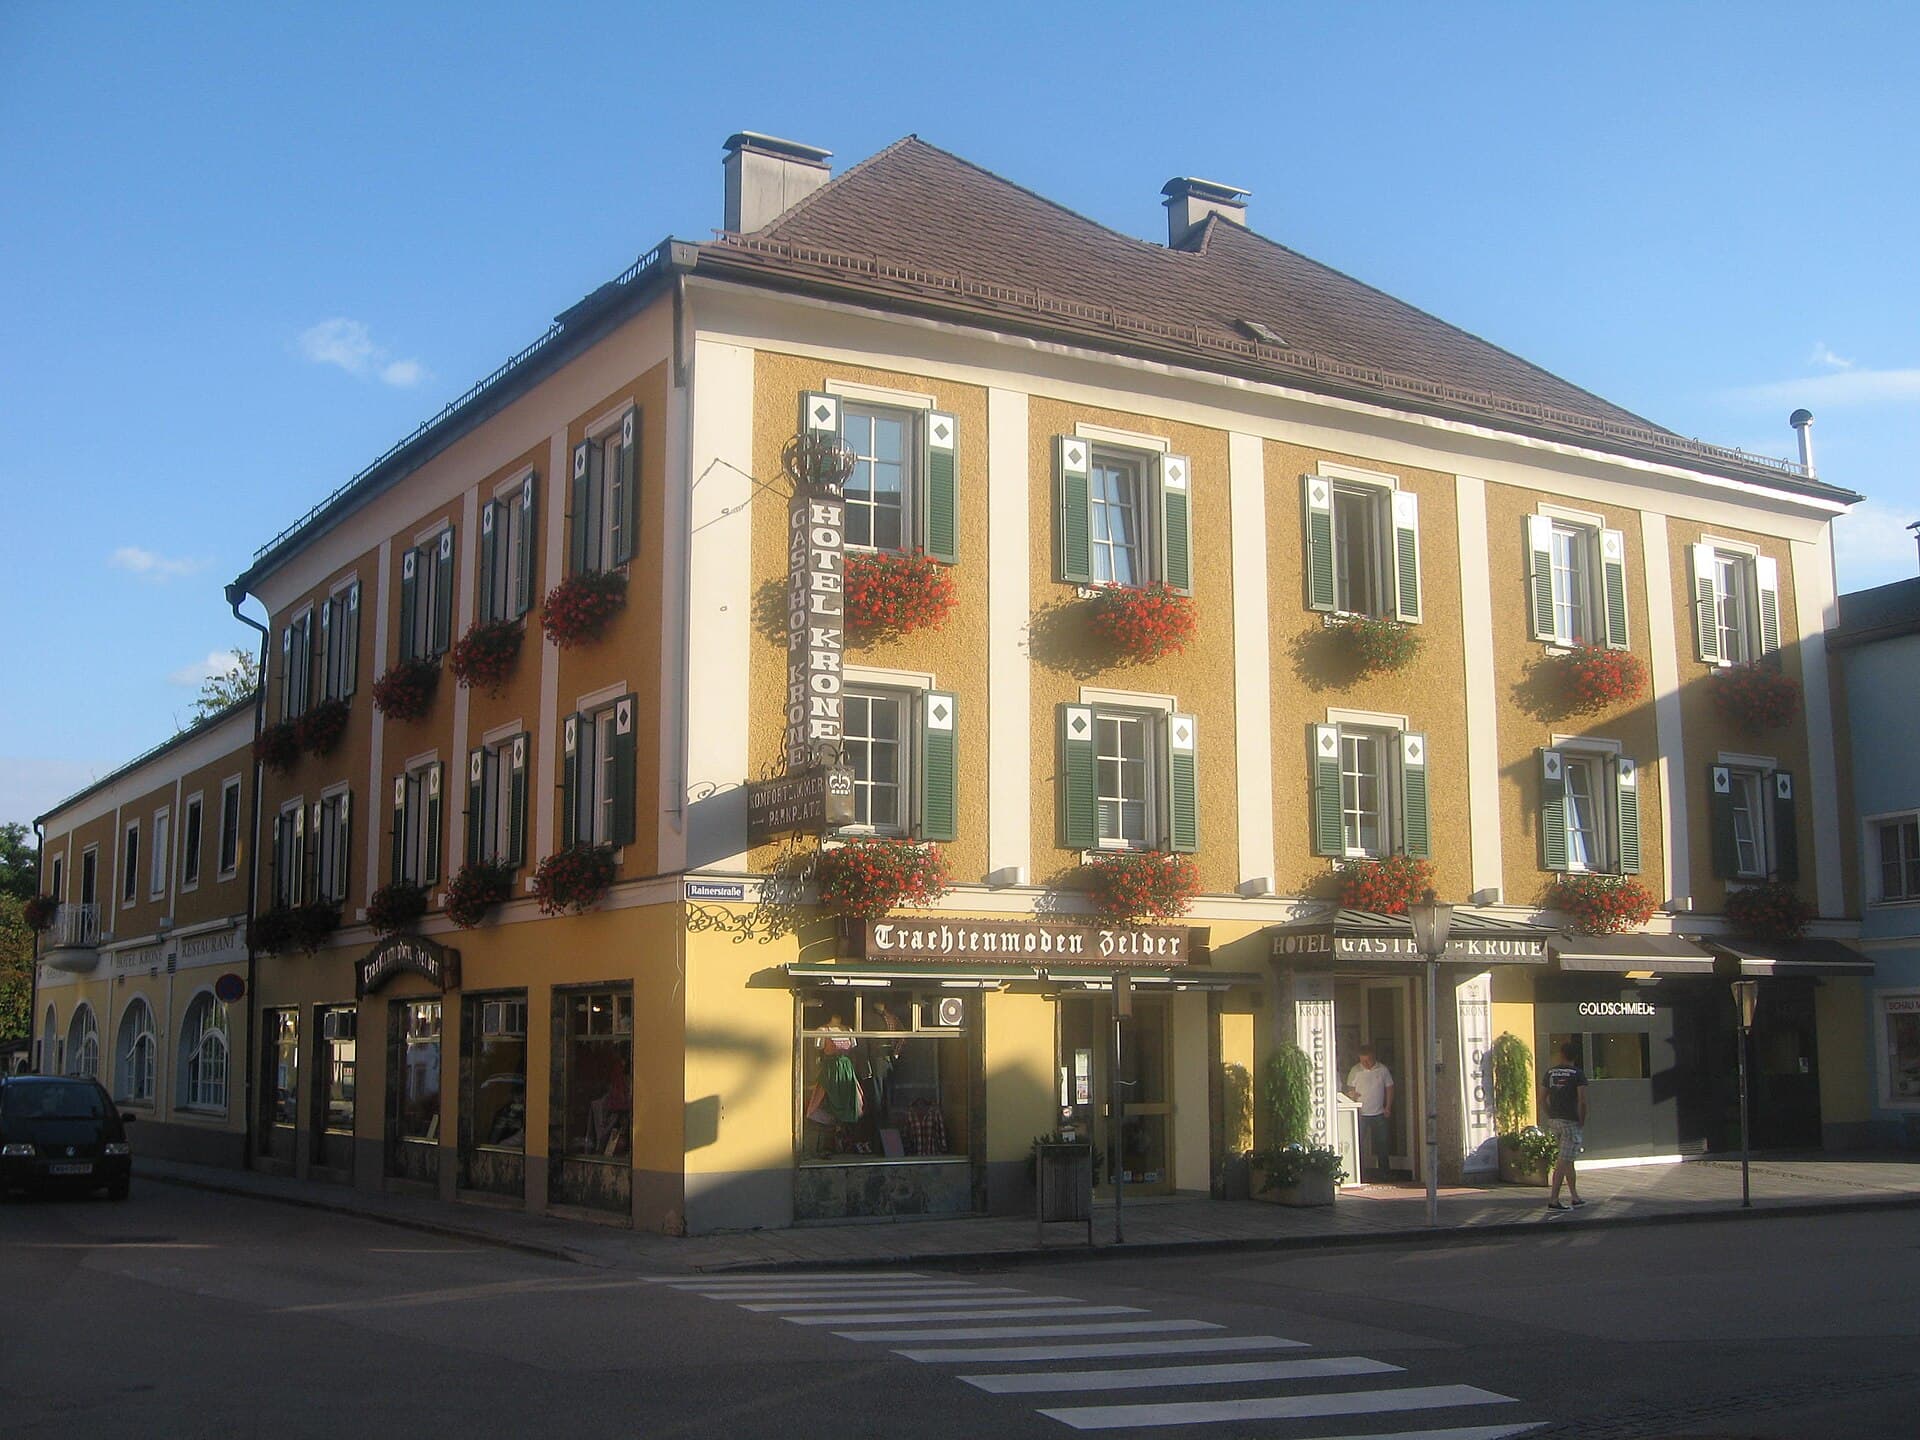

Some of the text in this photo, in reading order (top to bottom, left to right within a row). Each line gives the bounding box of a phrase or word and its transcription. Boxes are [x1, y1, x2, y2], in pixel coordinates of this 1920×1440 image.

[810, 504, 842, 741] HOTEL KRONE
[789, 508, 806, 767] GASTHOF KRONE
[691, 885, 742, 896] Rainerstraße
[181, 935, 235, 958] RESTAURANT
[874, 923, 1084, 954] Trachtenmoden
[1272, 933, 1331, 955] HOTEL
[1467, 939, 1544, 957] KRONE
[1299, 1005, 1332, 1017] KRONE
[1459, 1005, 1489, 1017] KRONE
[1578, 1002, 1656, 1016] GOLDSCHMIEDE
[1311, 1027, 1327, 1148] Restaurant
[1468, 1037, 1488, 1129] Hotel
